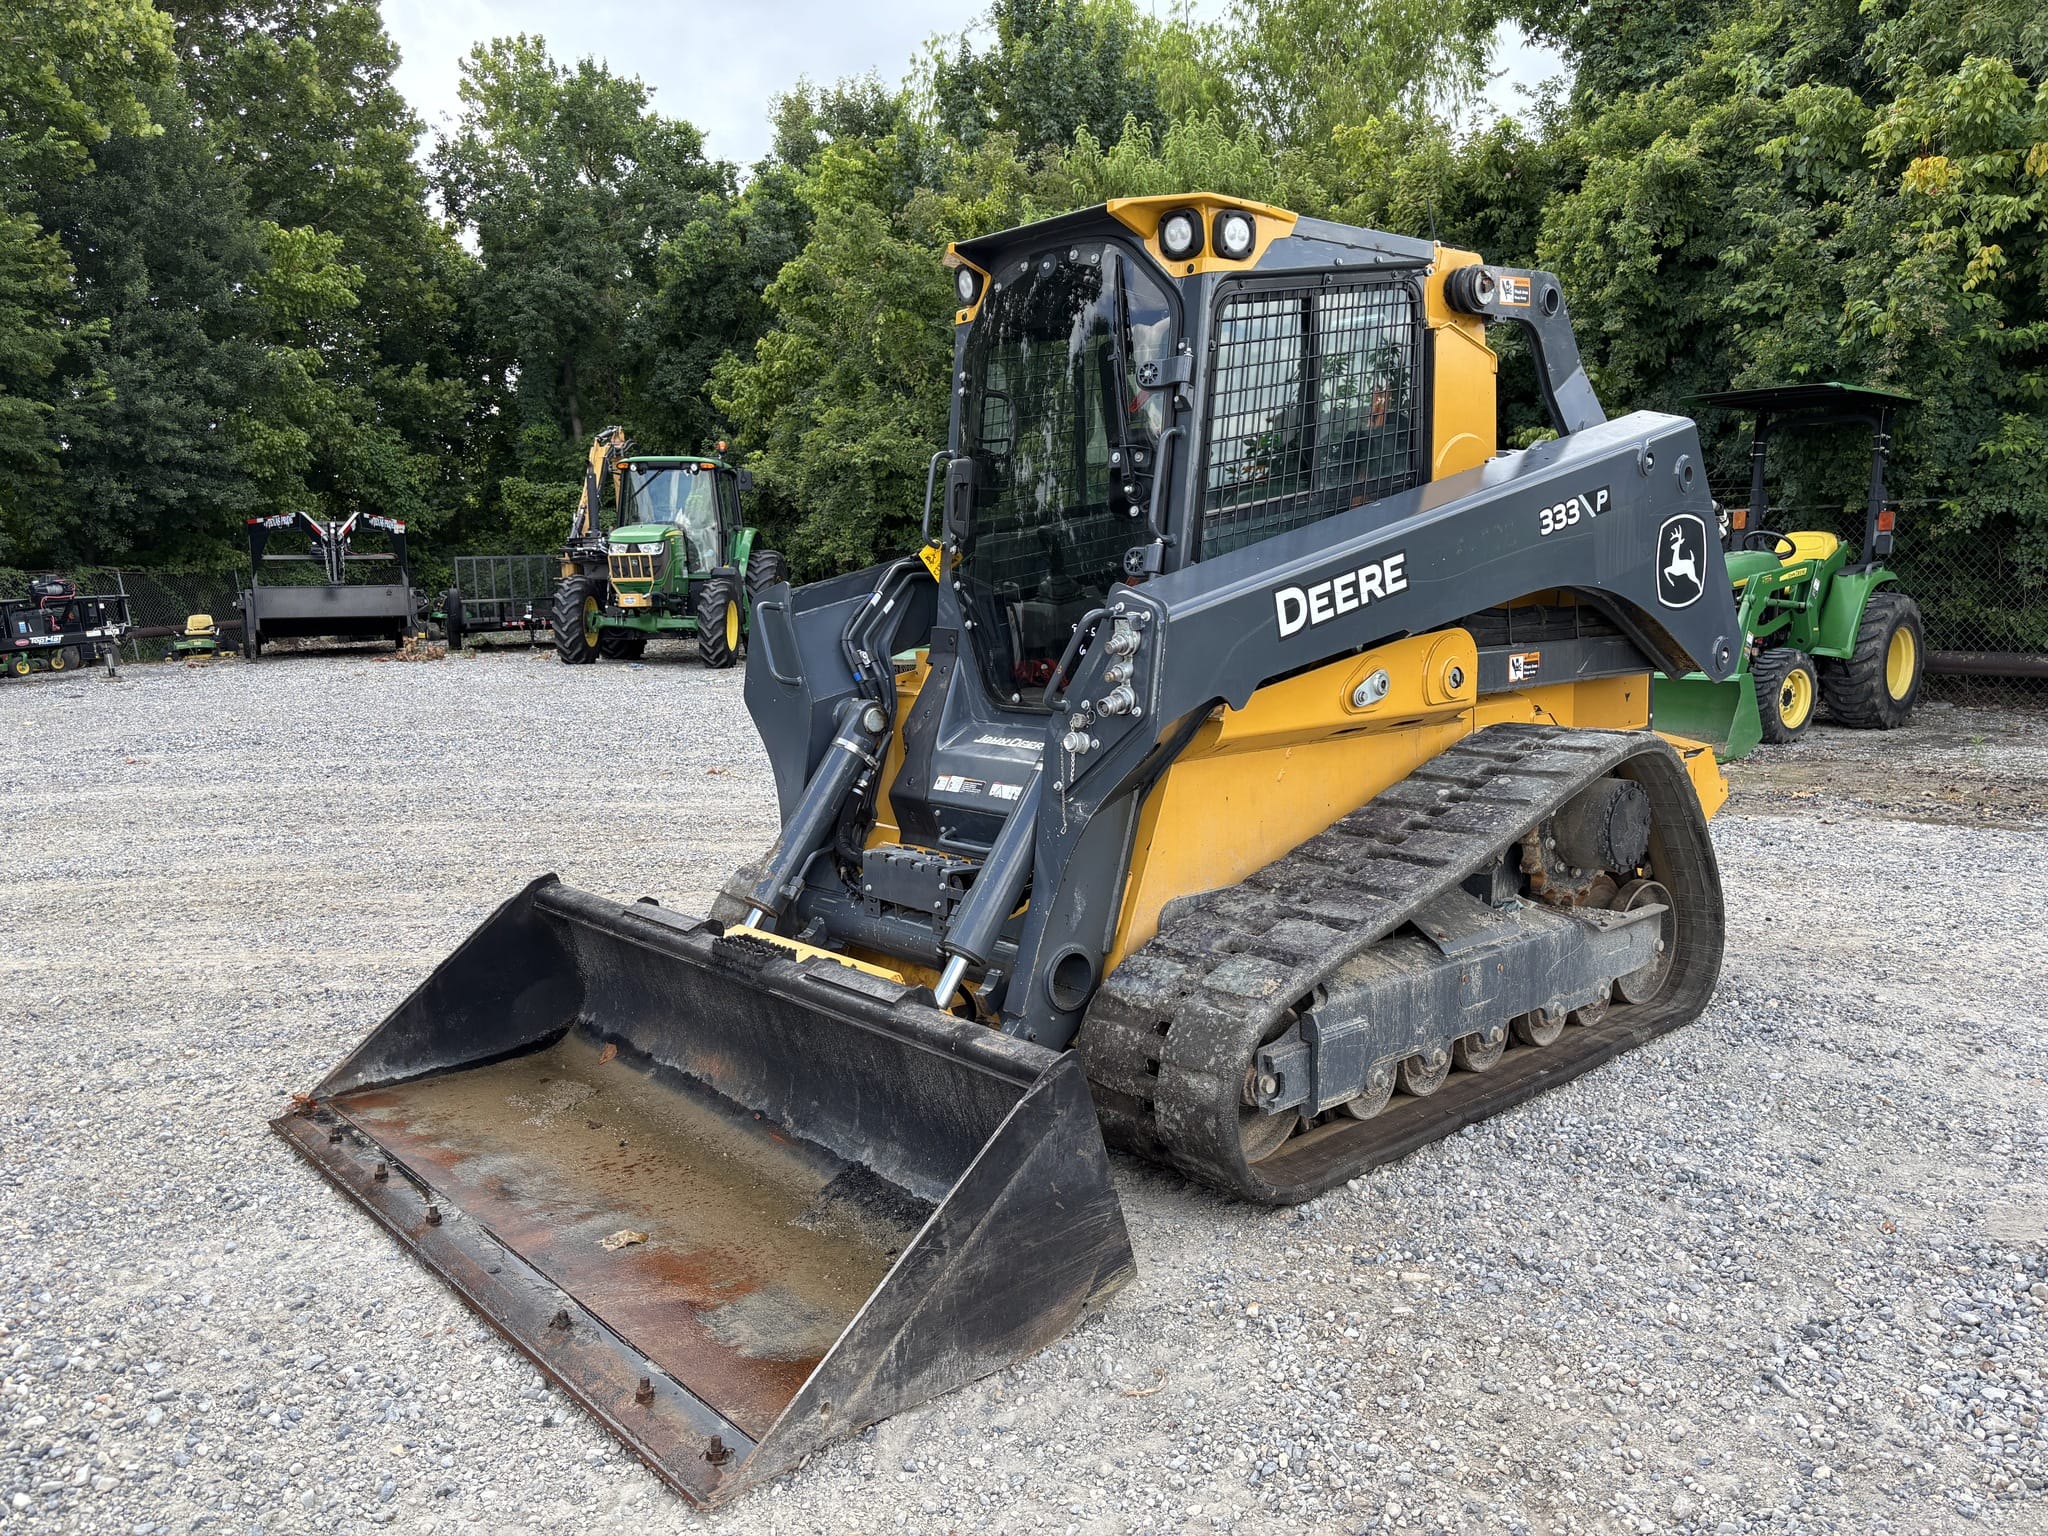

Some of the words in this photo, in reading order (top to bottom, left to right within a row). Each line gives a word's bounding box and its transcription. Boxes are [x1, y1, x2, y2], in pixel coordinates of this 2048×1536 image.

[1275, 553, 1408, 638] DEERE
[973, 734, 1012, 747] JOHN
[1010, 738, 1046, 751] DEER
